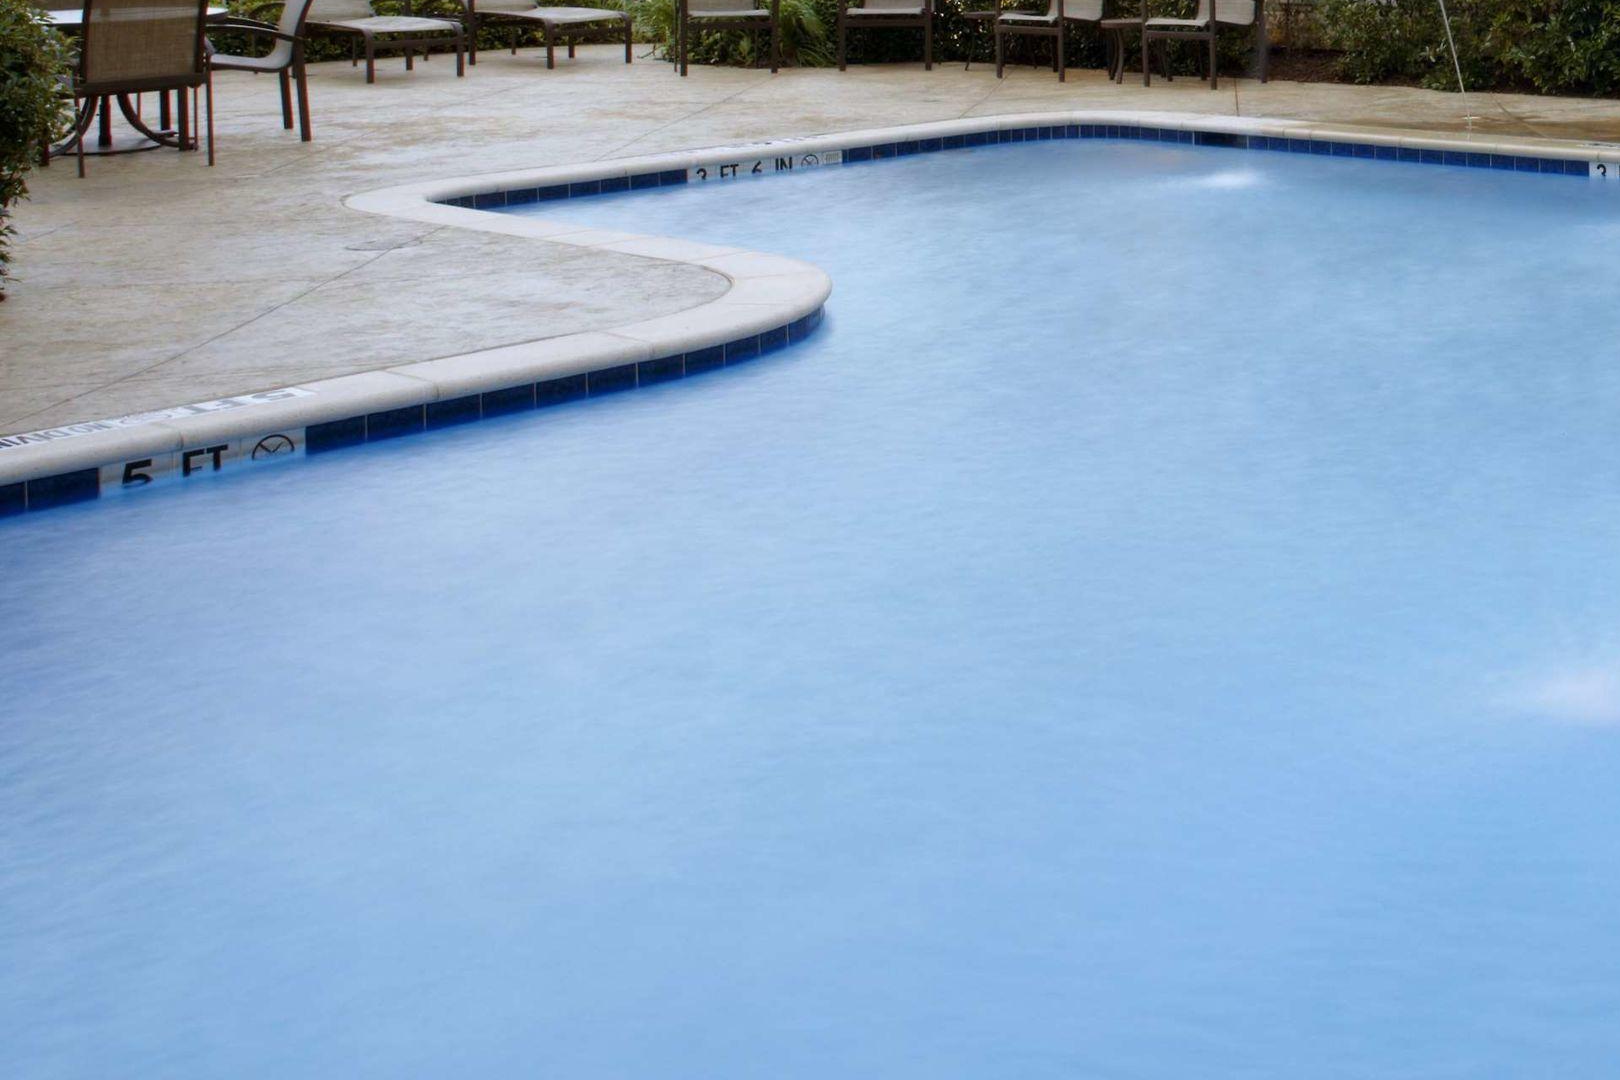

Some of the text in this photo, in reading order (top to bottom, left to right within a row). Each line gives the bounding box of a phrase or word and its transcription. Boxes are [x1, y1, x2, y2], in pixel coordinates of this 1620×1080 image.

[775, 156, 793, 172] IN
[121, 444, 229, 486] 5 FT
